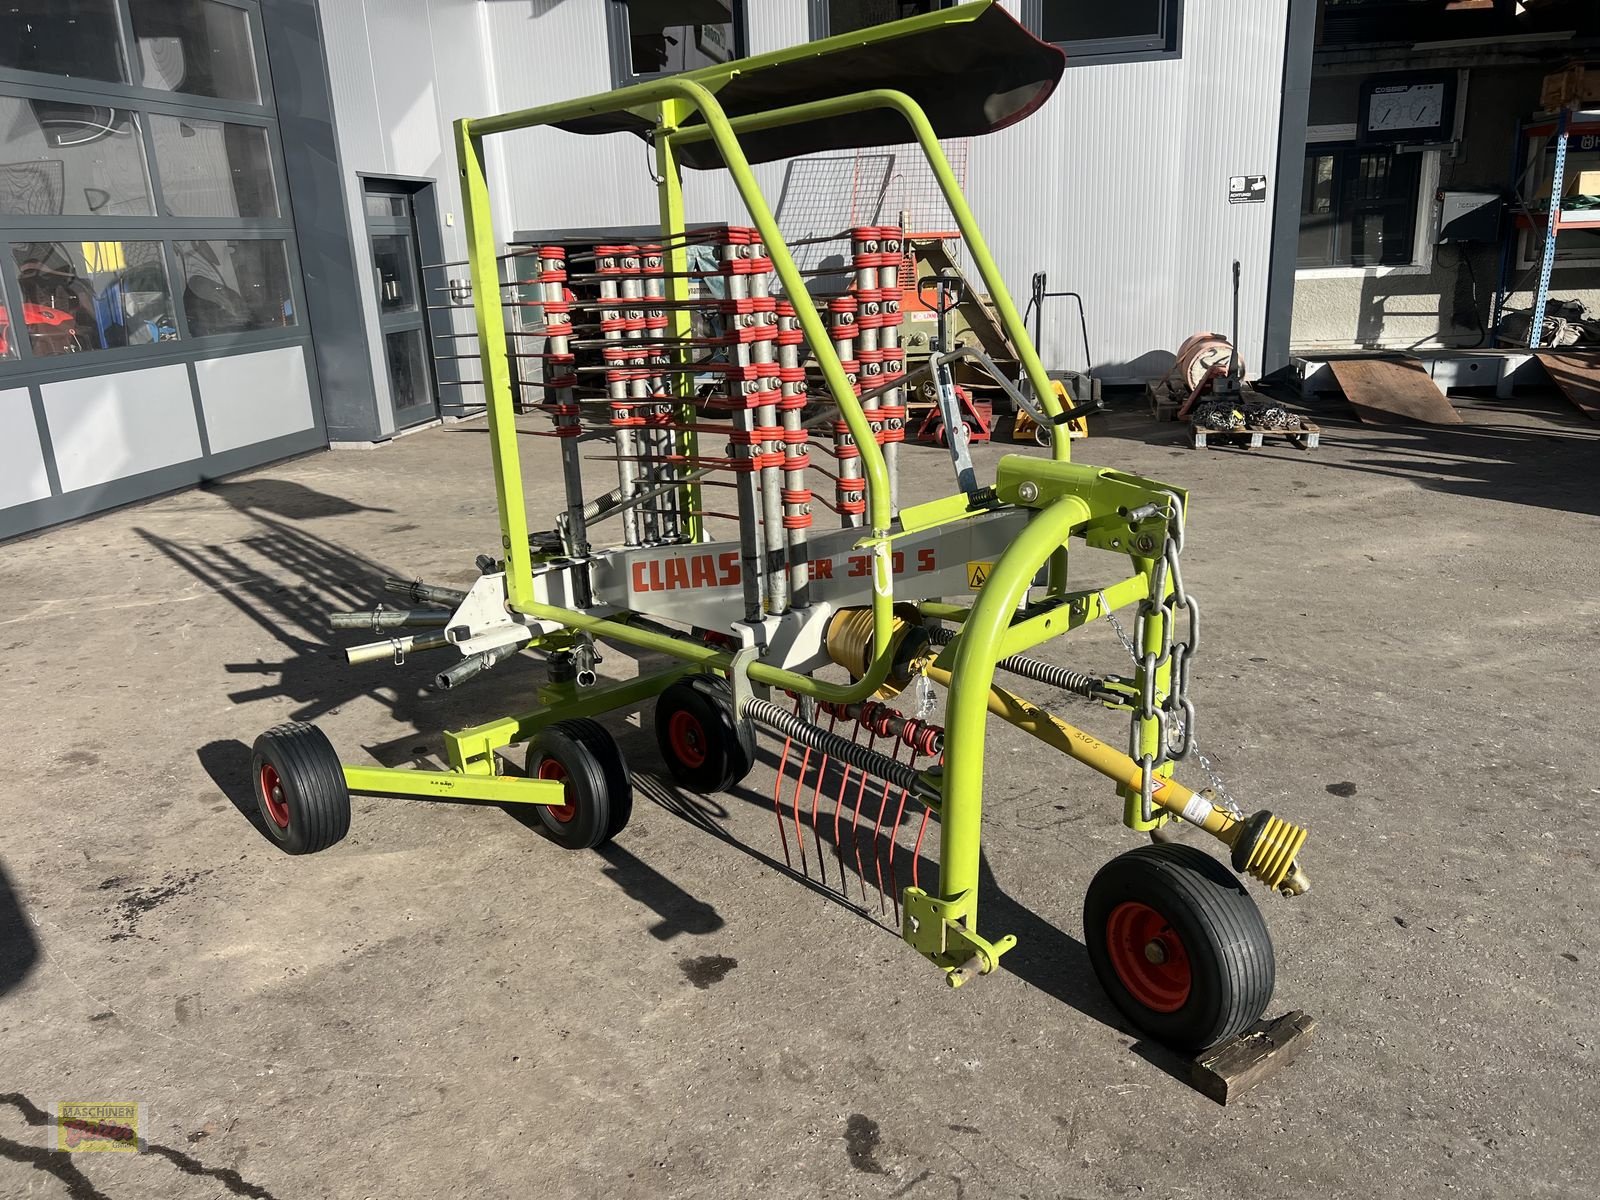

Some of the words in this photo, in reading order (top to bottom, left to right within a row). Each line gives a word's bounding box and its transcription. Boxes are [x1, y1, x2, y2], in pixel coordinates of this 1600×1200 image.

[632, 552, 741, 592] CLAAS
[917, 549, 936, 572] S
[1074, 732, 1094, 743] 350
